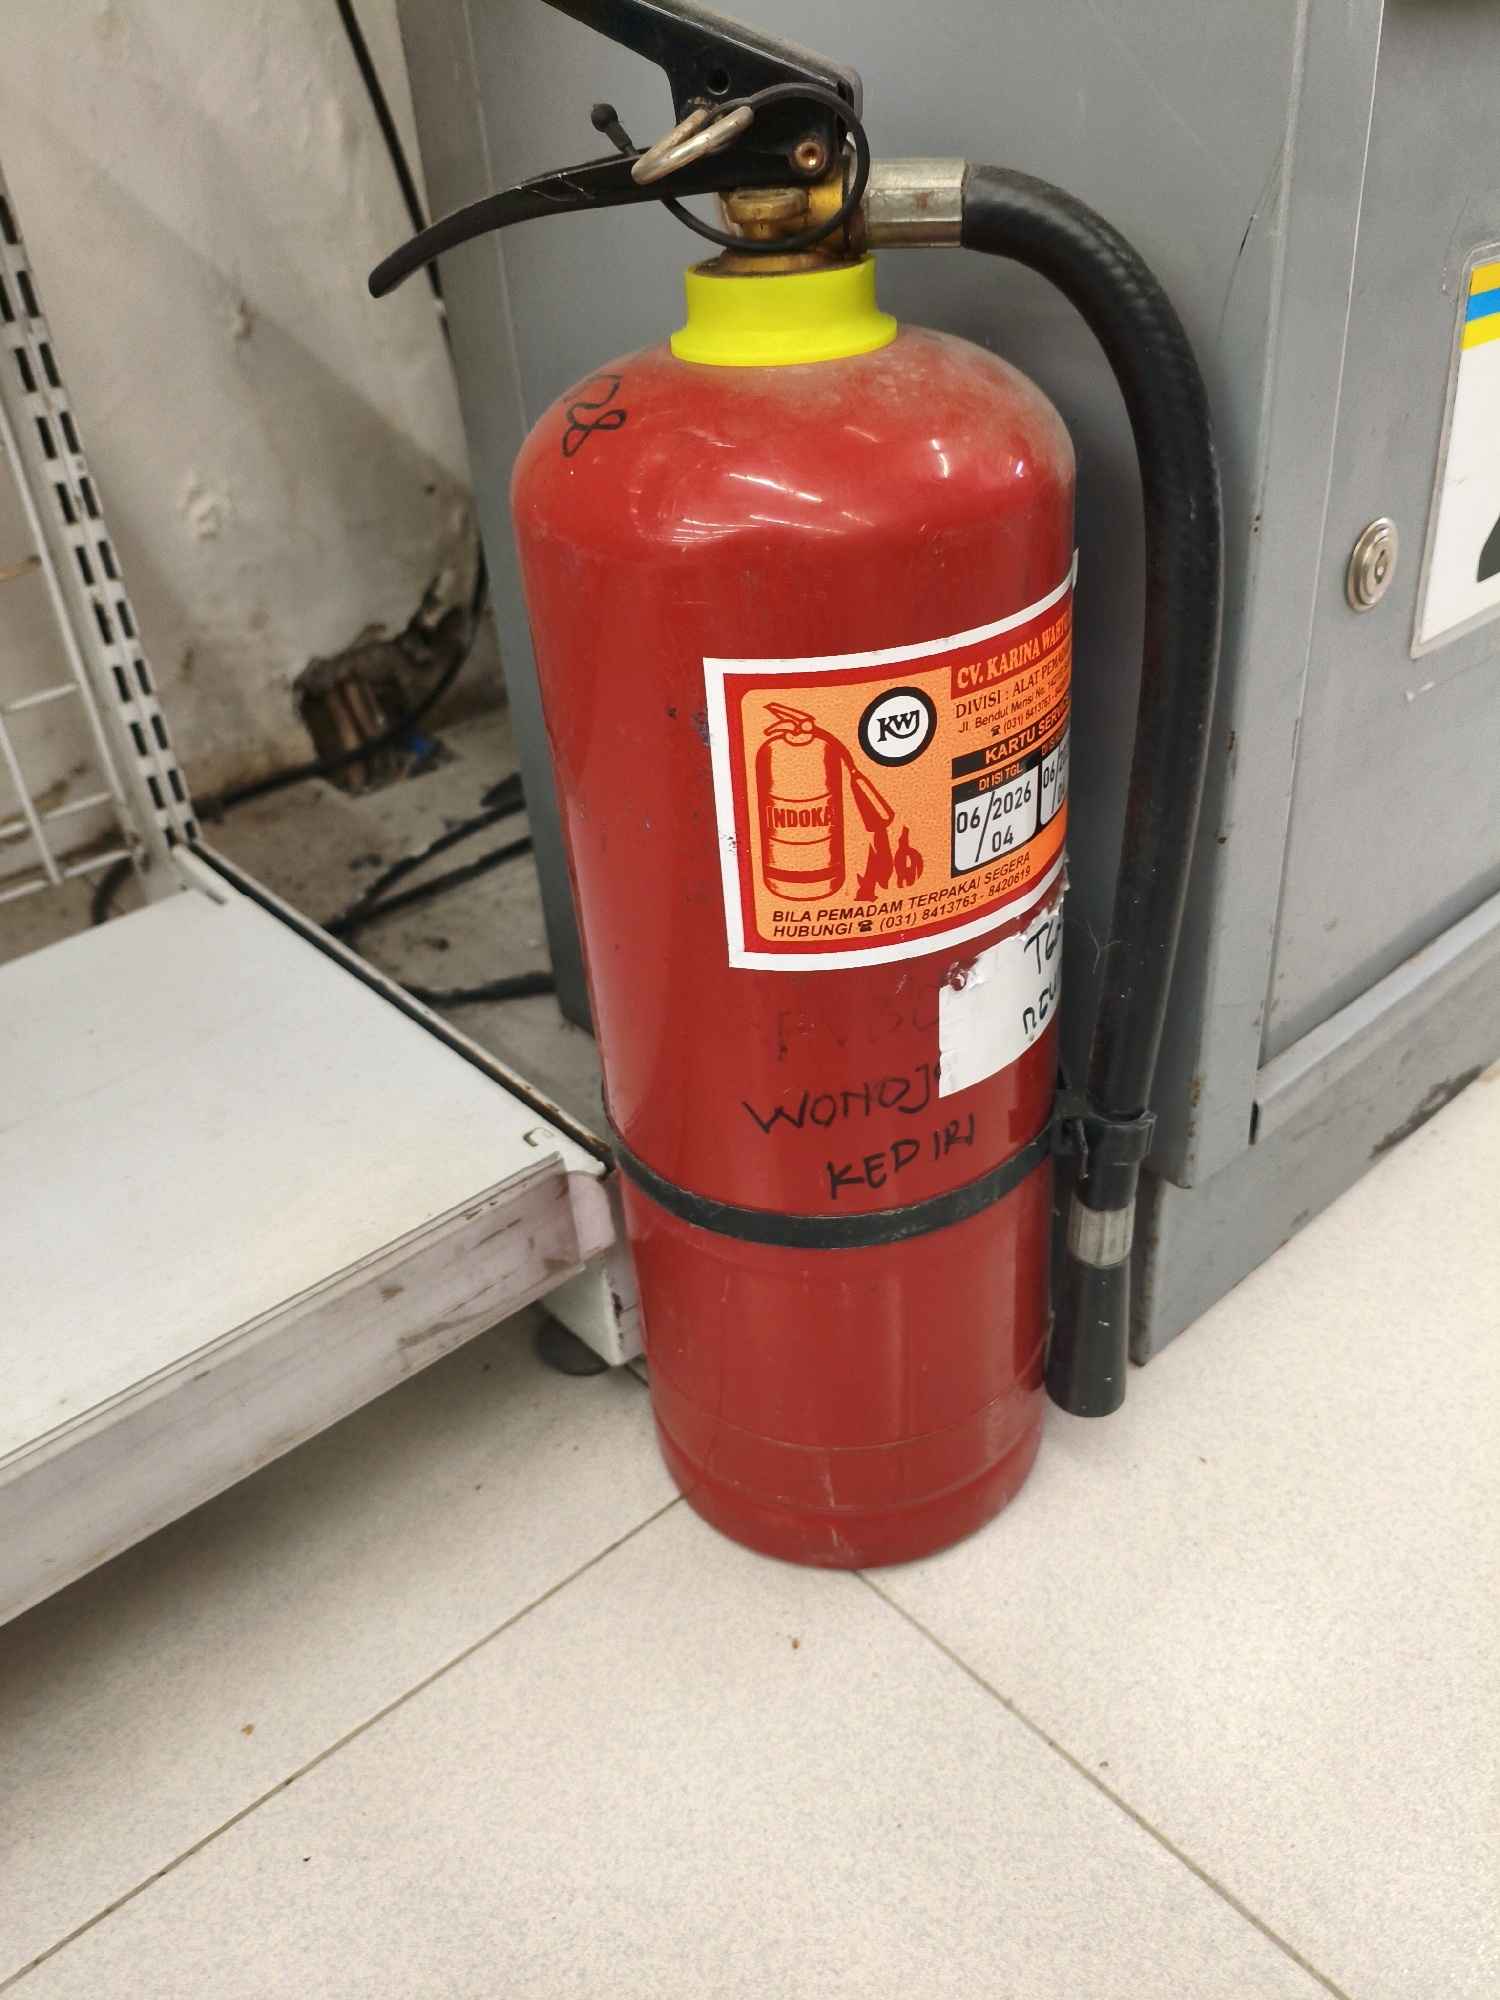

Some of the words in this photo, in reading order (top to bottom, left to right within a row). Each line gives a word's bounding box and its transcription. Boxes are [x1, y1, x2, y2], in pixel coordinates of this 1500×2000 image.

[956, 662, 984, 689] CV.
[986, 636, 1041, 682] KARINA
[955, 689, 1002, 719] DIVISI
[1012, 669, 1040, 698] ALAT
[958, 720, 971, 734] Jl.
[975, 703, 1009, 729] Bendul
[1011, 692, 1034, 712] Merisi
[876, 709, 921, 742] KWJ
[1003, 713, 1024, 734] (031)
[985, 727, 1037, 765] KARTU
[1005, 762, 1023, 781] TGL
[767, 805, 835, 829] INDOKA
[991, 825, 1014, 853] 04
[772, 909, 812, 923] BILA
[816, 899, 903, 922] PEMADAM
[909, 876, 981, 909] TERPAKAI
[984, 852, 1031, 886] SEGERA
[773, 923, 853, 938] HUBUNGI
[879, 912, 917, 933] (031)
[922, 895, 977, 920] 8413763
[988, 865, 1032, 897] 8420619
